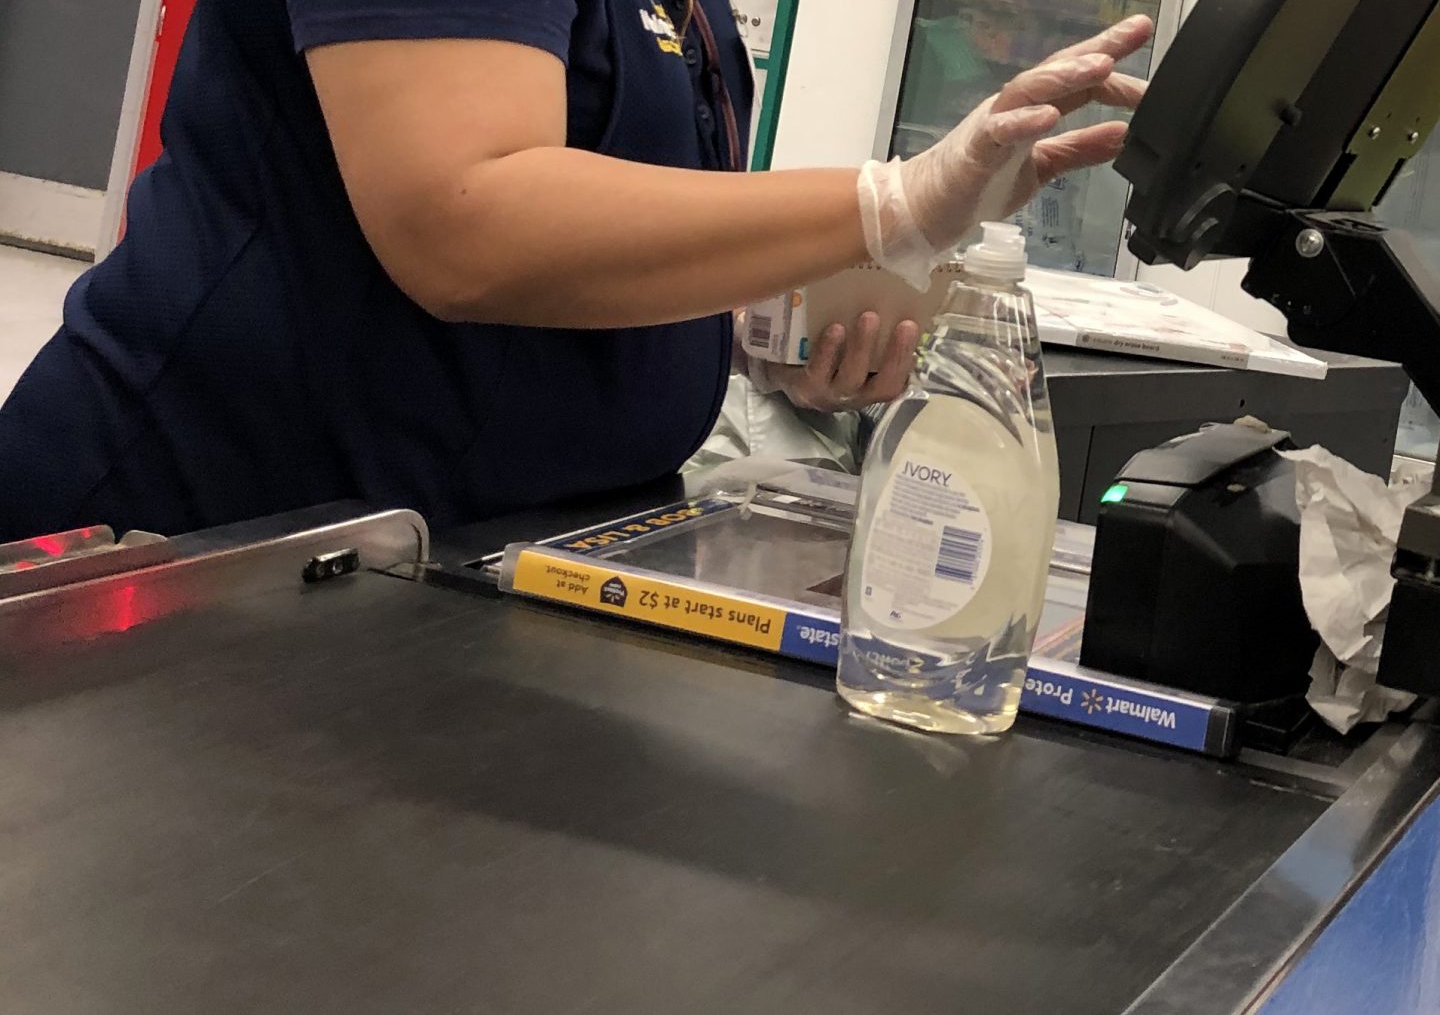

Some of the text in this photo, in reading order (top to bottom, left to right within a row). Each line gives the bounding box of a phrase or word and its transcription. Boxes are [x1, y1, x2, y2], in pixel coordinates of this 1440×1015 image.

[901, 460, 952, 487] IVORY
[556, 579, 588, 595] Add at
[638, 589, 772, 634] Plans start at $2
[1105, 696, 1175, 729] Walmart
